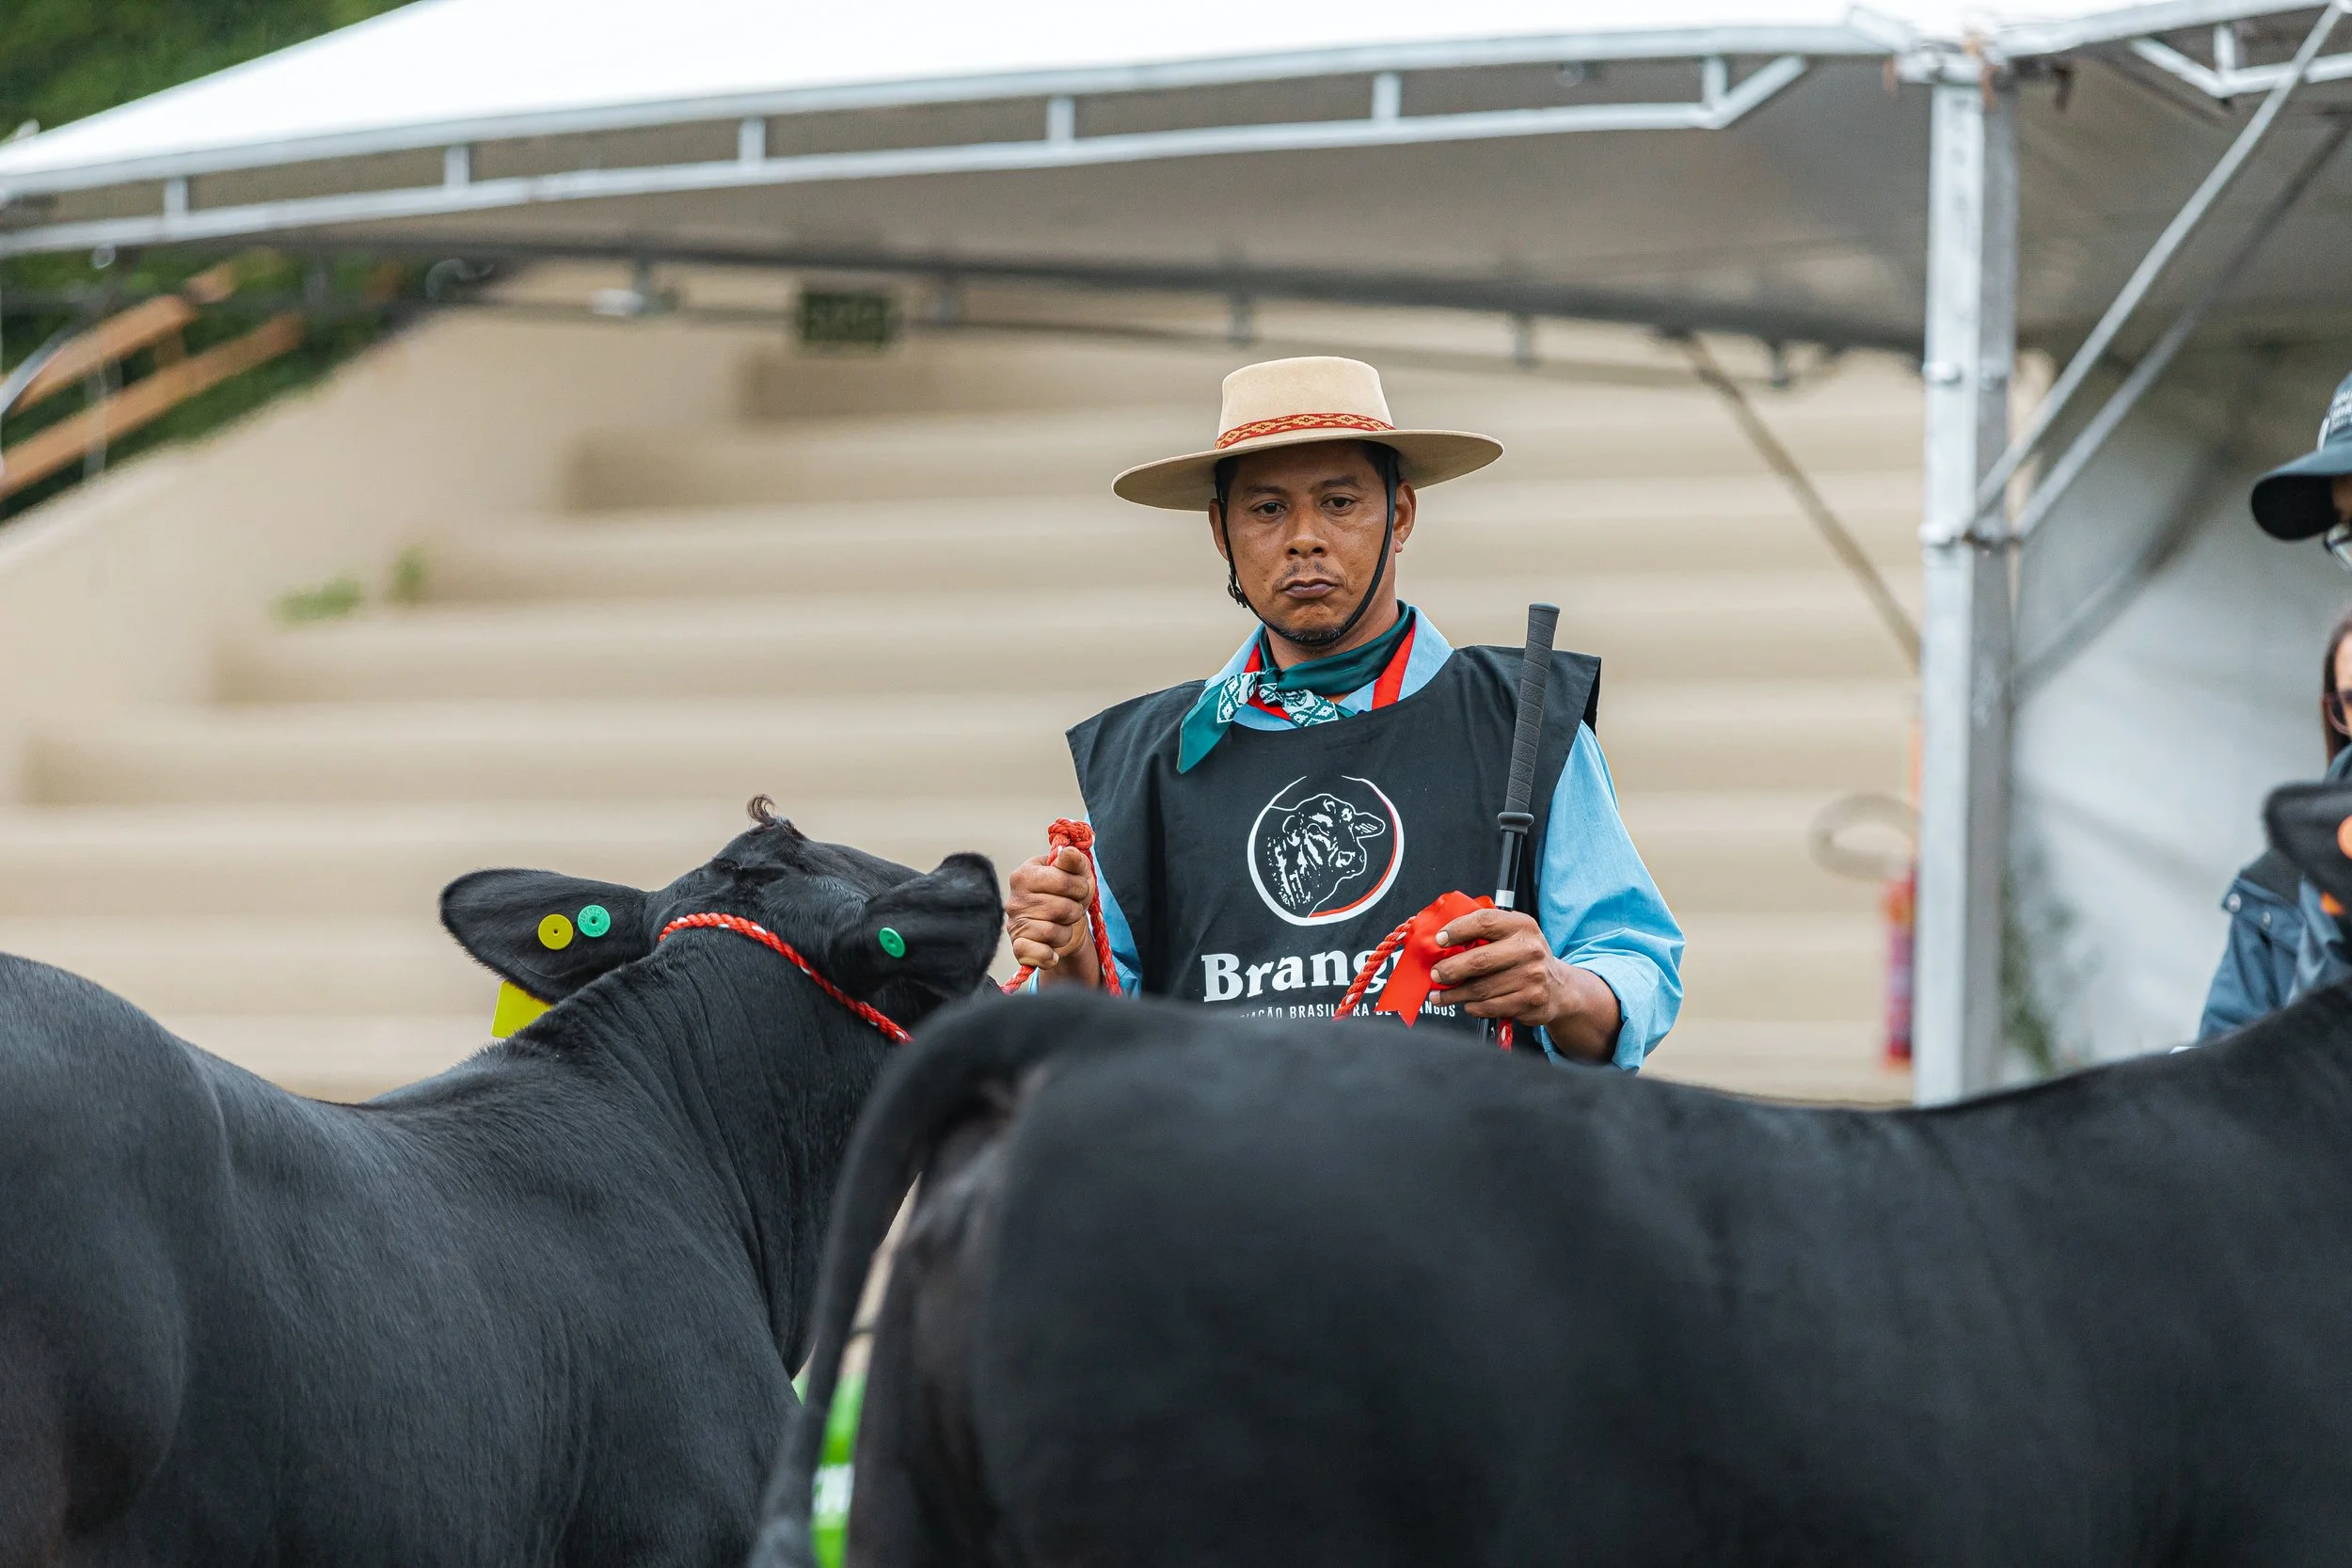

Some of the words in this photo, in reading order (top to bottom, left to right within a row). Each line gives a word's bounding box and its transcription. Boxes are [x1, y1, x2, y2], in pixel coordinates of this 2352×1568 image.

[1201, 949, 1404, 1002] Brang
[1290, 1003, 1370, 1019] BRASILRA
[1399, 1000, 1456, 1017] NGUS
